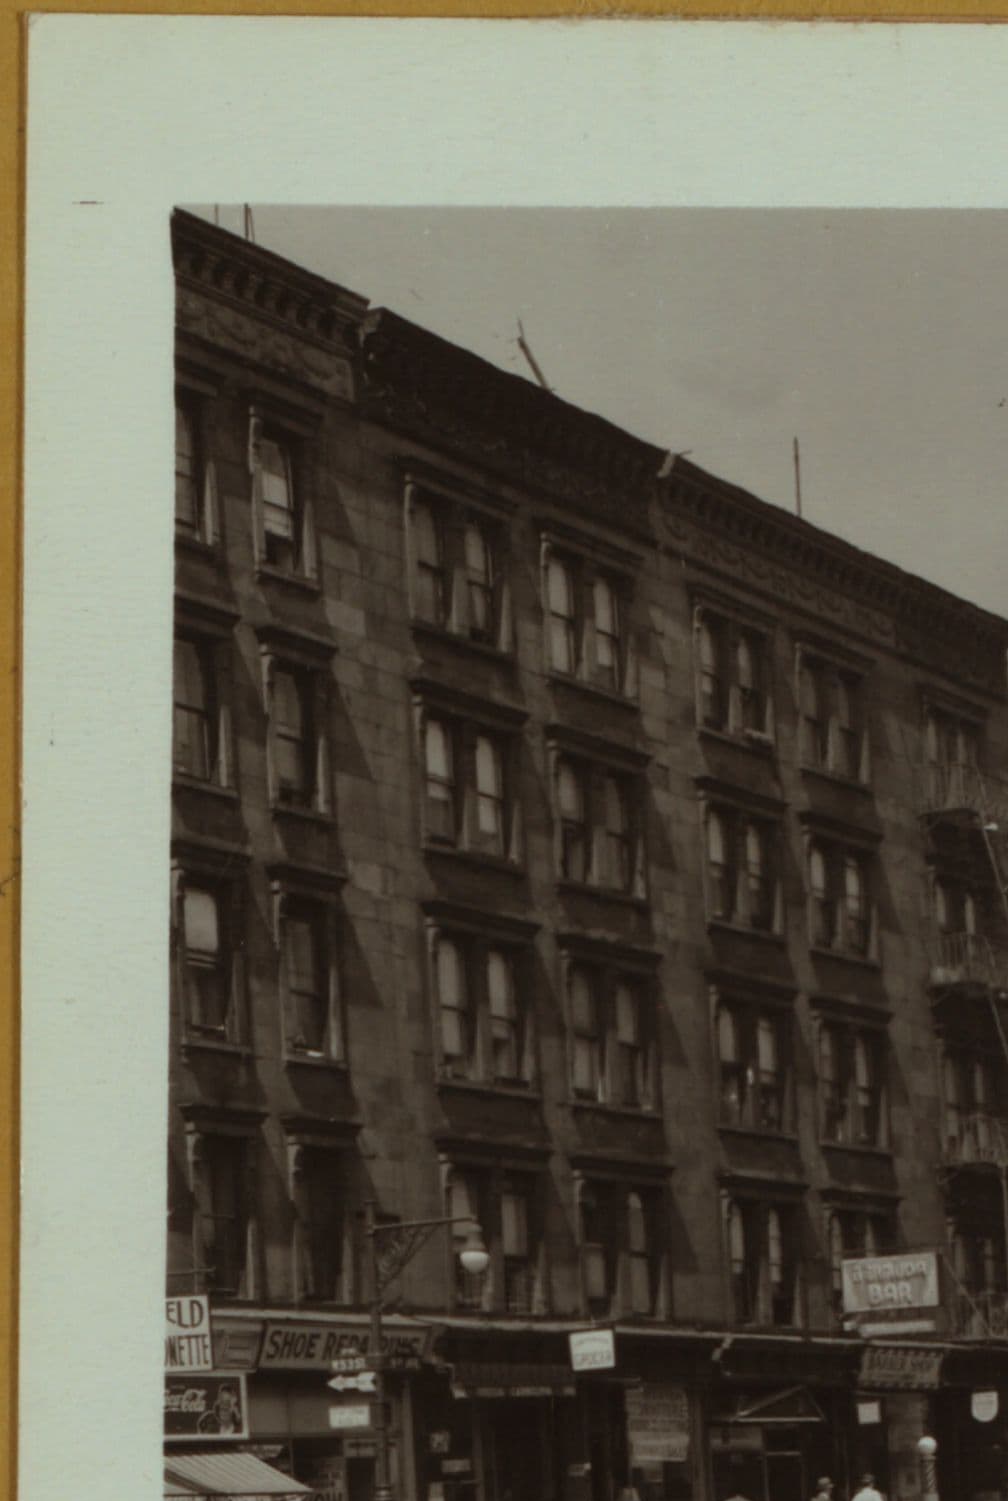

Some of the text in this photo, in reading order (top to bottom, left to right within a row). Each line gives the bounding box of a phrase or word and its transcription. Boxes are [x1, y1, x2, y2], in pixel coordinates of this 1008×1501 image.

[868, 1281, 913, 1305] BAR
[267, 1330, 421, 1361] SHOE REPARING
